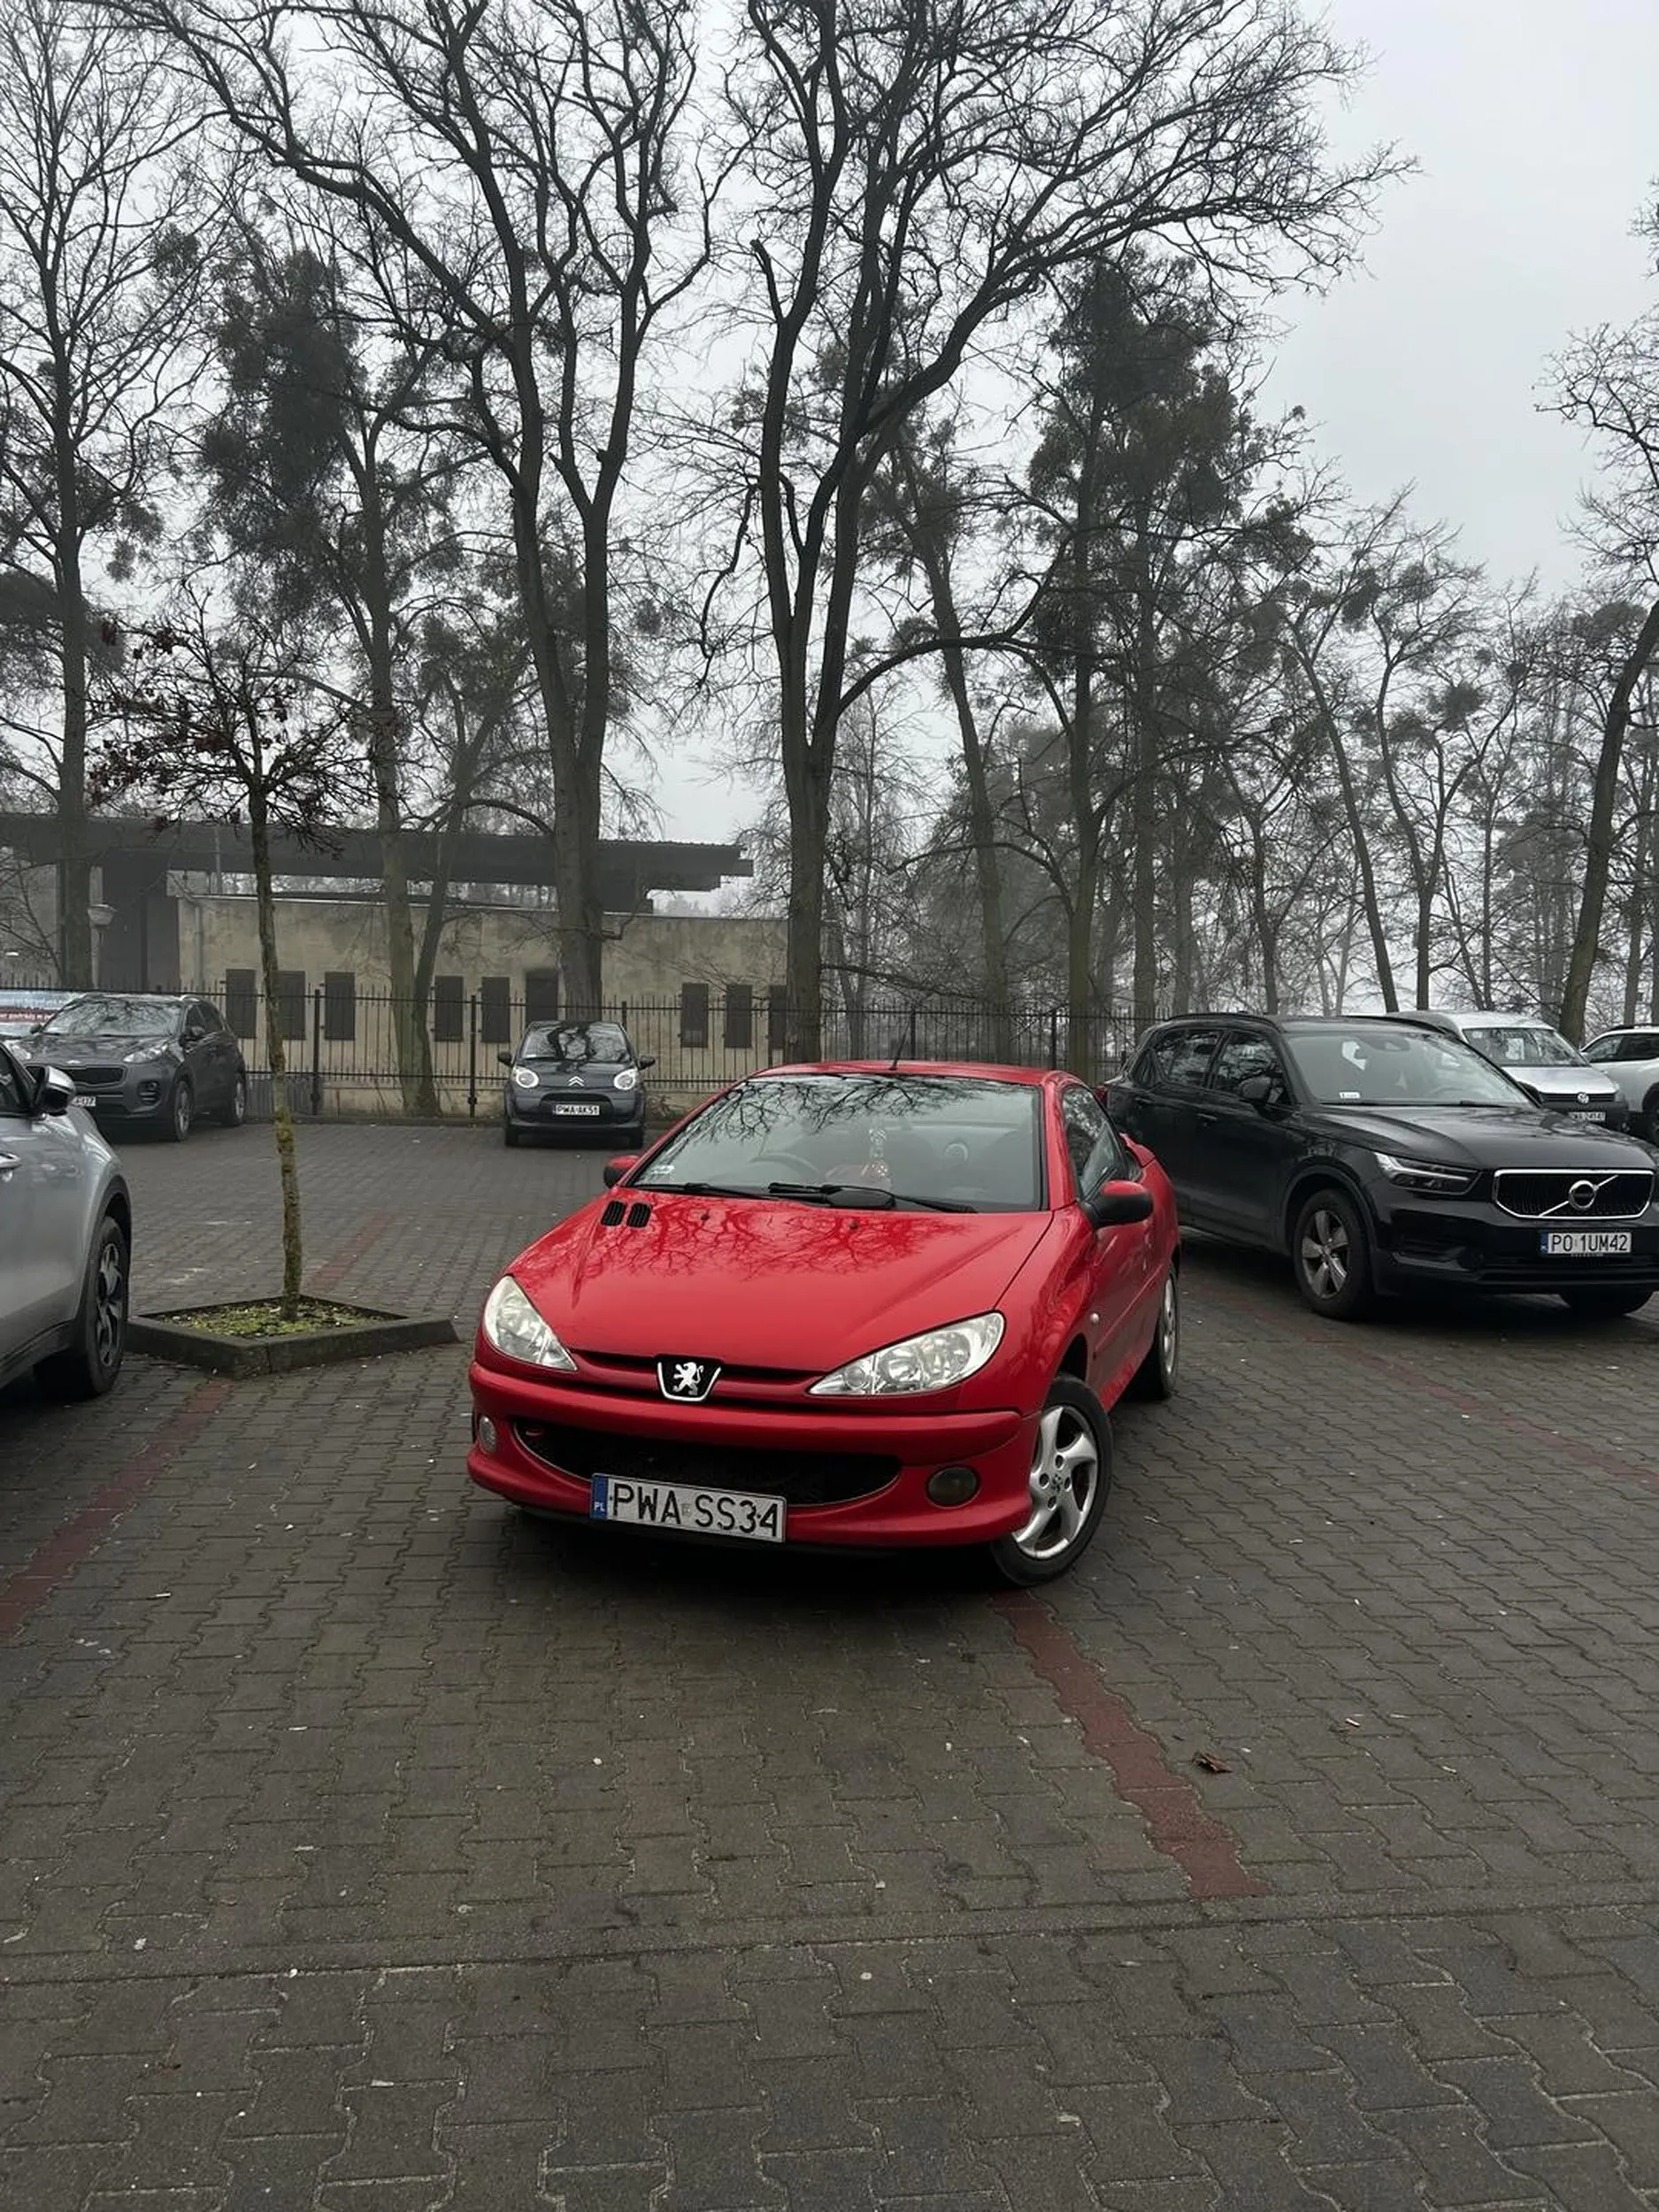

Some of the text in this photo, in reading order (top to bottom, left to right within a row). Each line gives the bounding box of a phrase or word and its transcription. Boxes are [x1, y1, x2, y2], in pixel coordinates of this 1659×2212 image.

[1552, 1234, 1627, 1251] PO 1UM42
[594, 1502, 605, 1512] PL
[613, 1483, 778, 1537] PWA SS34
